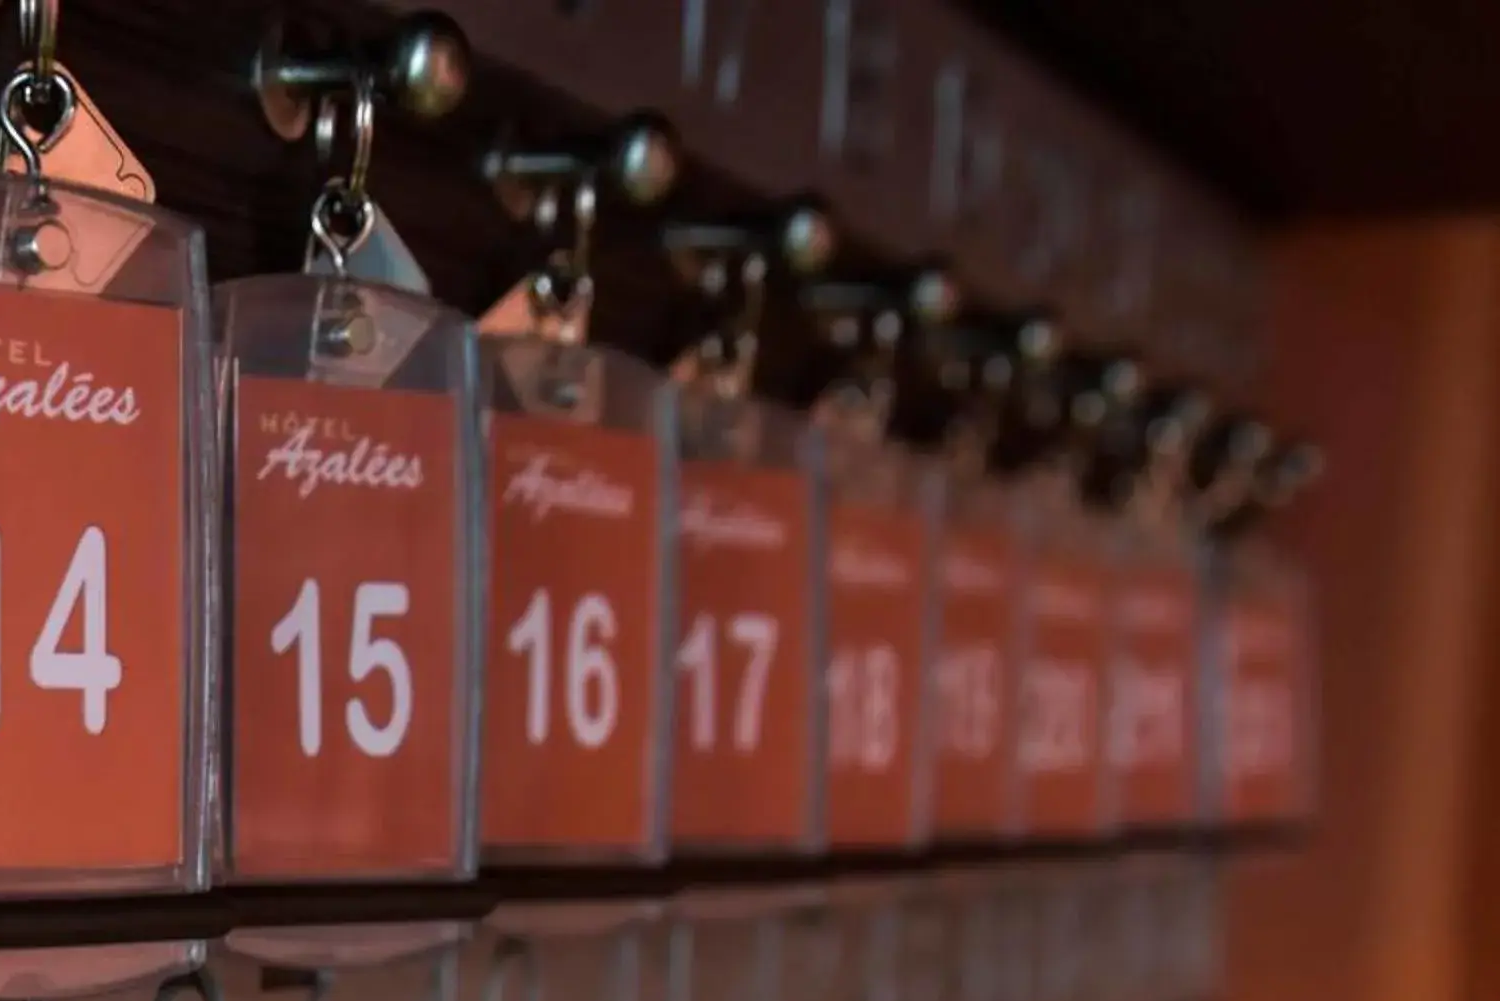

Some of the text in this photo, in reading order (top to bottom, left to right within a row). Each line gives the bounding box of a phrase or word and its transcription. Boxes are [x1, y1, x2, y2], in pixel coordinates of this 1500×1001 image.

[256, 426, 424, 499] Azalées
[271, 578, 412, 757] 15
[509, 588, 618, 749] 16
[675, 614, 778, 752] 17
